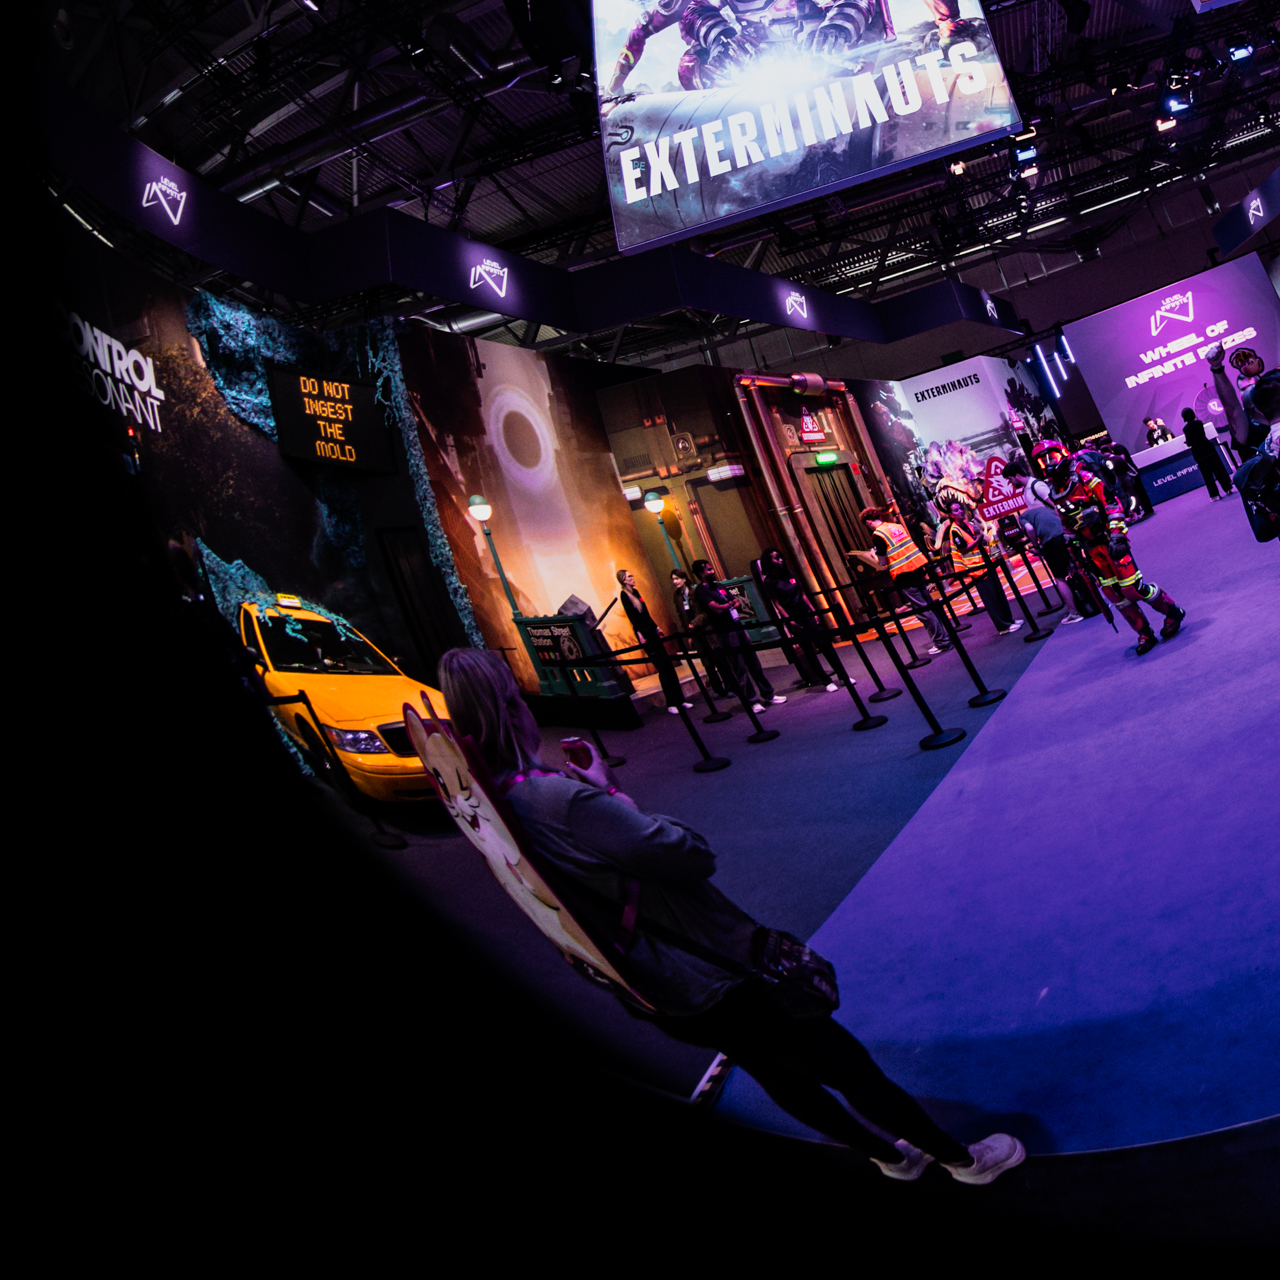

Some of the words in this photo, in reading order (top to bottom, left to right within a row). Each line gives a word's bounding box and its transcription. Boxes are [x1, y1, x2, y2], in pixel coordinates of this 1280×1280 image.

[618, 40, 988, 206] EXTERMINAUTS
[1161, 293, 1184, 306] LEVEL
[58, 304, 166, 401] ONTROL
[1139, 332, 1205, 364] WHEEL
[1205, 319, 1229, 338] OF
[1124, 351, 1197, 389] INFINITE
[1196, 326, 1257, 360] PZES
[300, 376, 319, 395] DO
[323, 380, 350, 400] NOT
[914, 373, 981, 403] EXTERMINAUTS
[303, 397, 353, 421] INGEST
[317, 420, 346, 441] THE
[315, 440, 356, 462] MOLD
[1153, 473, 1178, 487] LEVEL
[526, 626, 552, 636] Thomas
[551, 625, 572, 636] Street
[530, 636, 554, 646] Station
